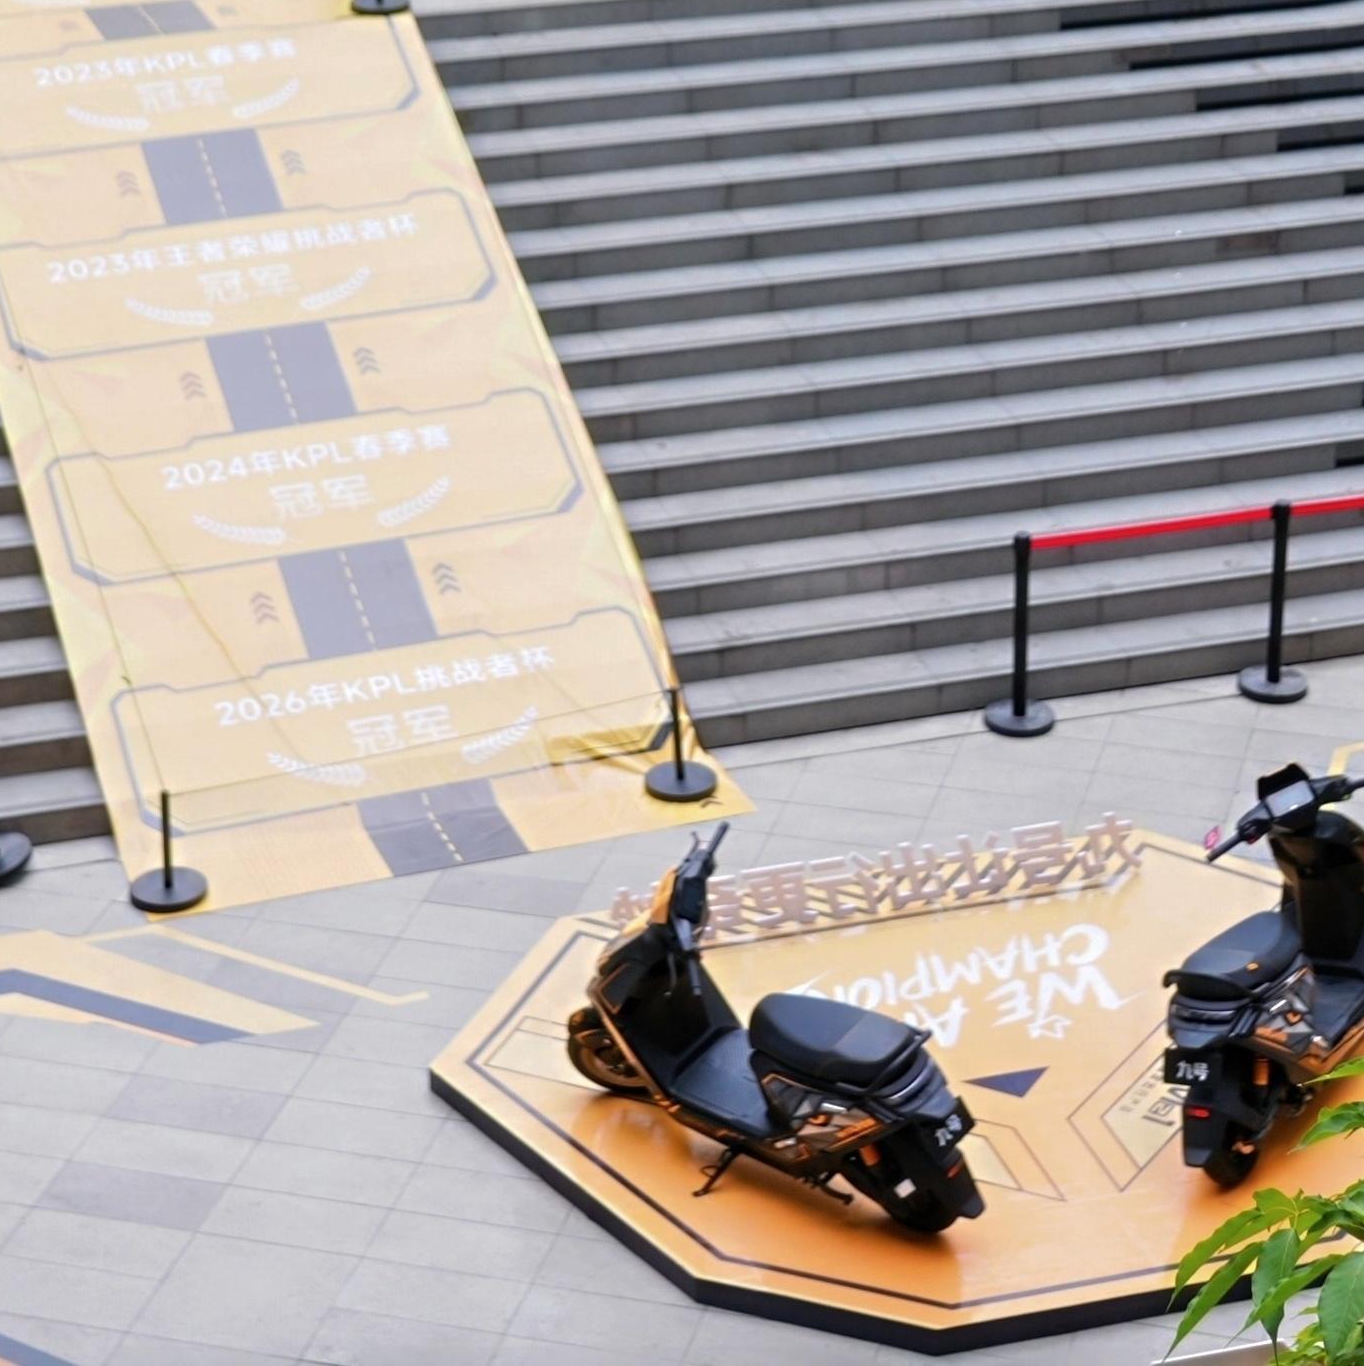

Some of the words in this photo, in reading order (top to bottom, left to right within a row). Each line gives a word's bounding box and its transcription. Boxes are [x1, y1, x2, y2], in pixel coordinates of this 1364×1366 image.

[46, 212, 419, 284] 2023年王者荣耀挑战者杯
[160, 423, 452, 491] 2024年KPL春季赛
[269, 473, 377, 521] 冠军
[213, 645, 556, 727] 2026年KPL挑战者杯
[346, 704, 459, 755] 冠军
[1174, 1060, 1210, 1082] 九号
